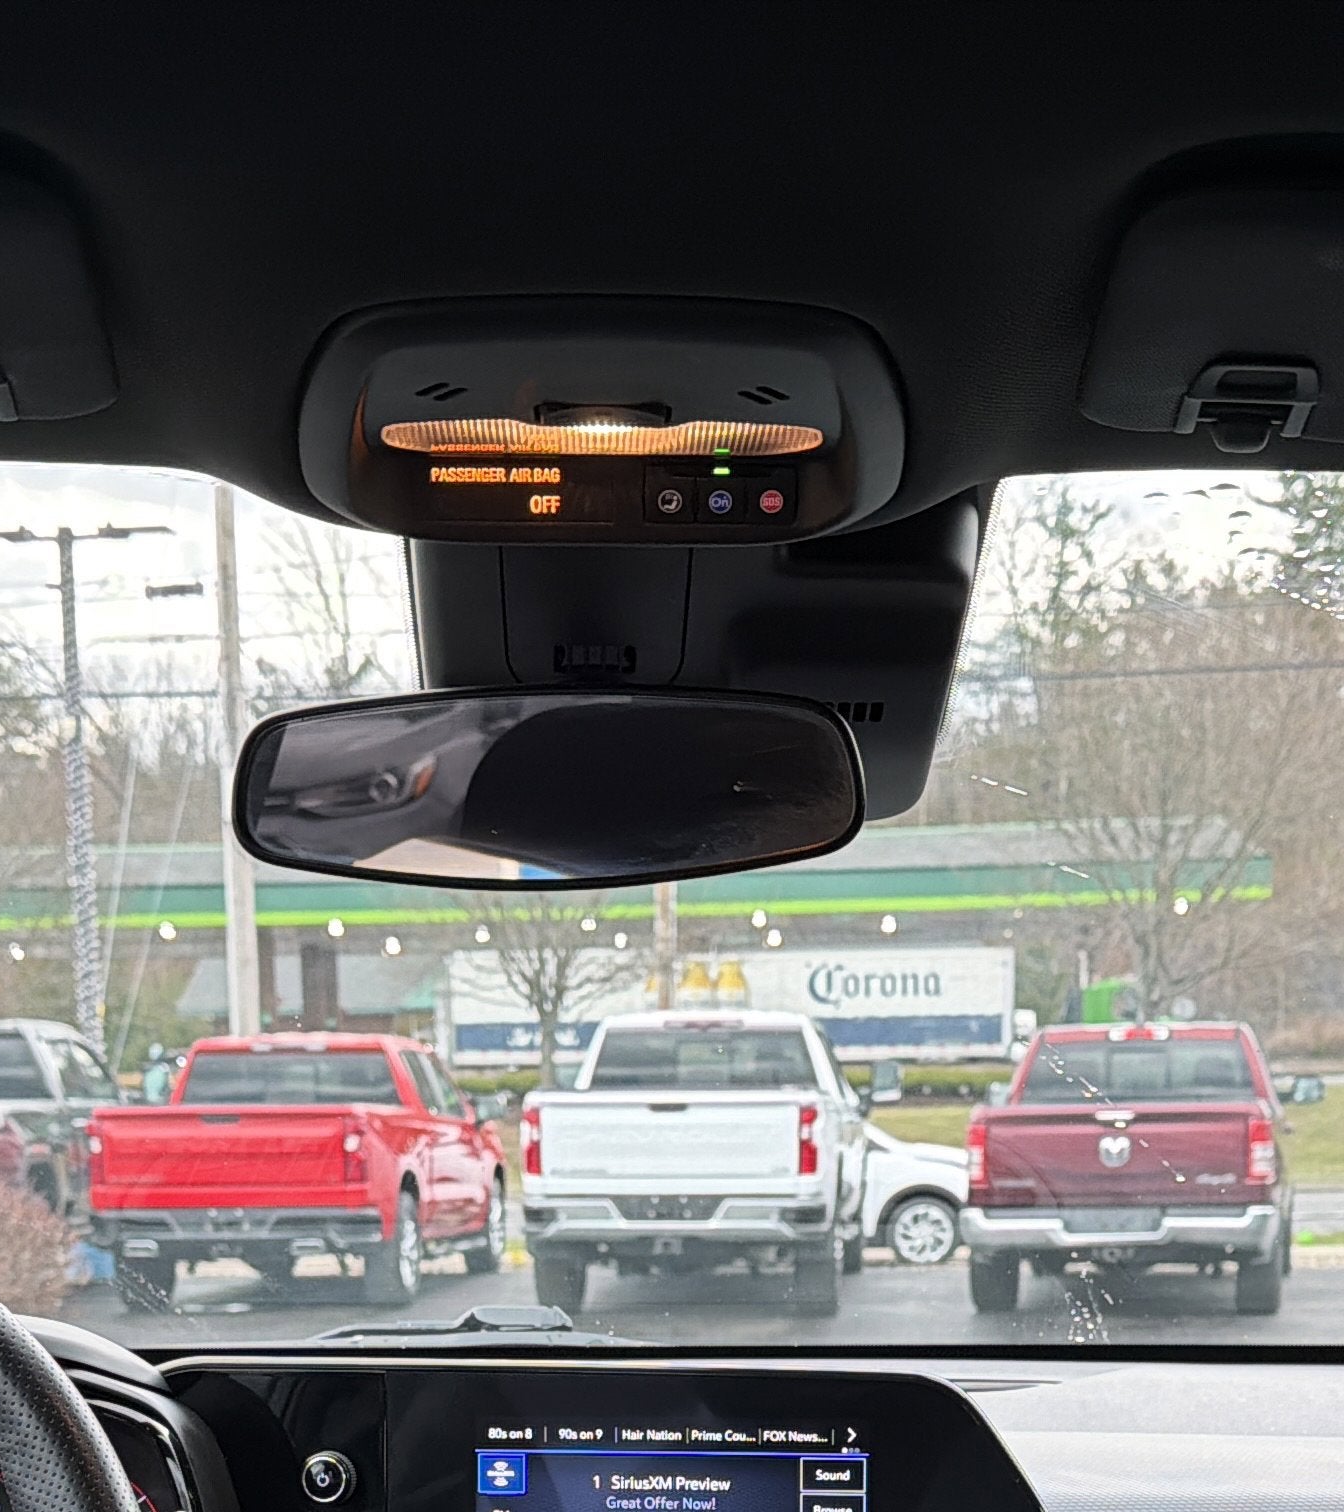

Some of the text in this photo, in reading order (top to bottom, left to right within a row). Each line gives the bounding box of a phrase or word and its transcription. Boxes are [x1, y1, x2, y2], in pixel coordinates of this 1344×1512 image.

[431, 467, 561, 484] PASSENGER AIR BAG
[529, 494, 561, 514] OFF
[807, 963, 942, 1006] Corona
[488, 1428, 533, 1440] 80s on 8
[558, 1428, 604, 1441] 90s on 9
[622, 1429, 682, 1441] Hair Nation
[691, 1430, 756, 1442] Prime Cou...
[763, 1430, 828, 1442] FOX News...
[814, 1469, 851, 1482] Sound
[592, 1475, 731, 1491] 1 SiriusXM Preview
[605, 1496, 717, 1510] Great Offer Now!
